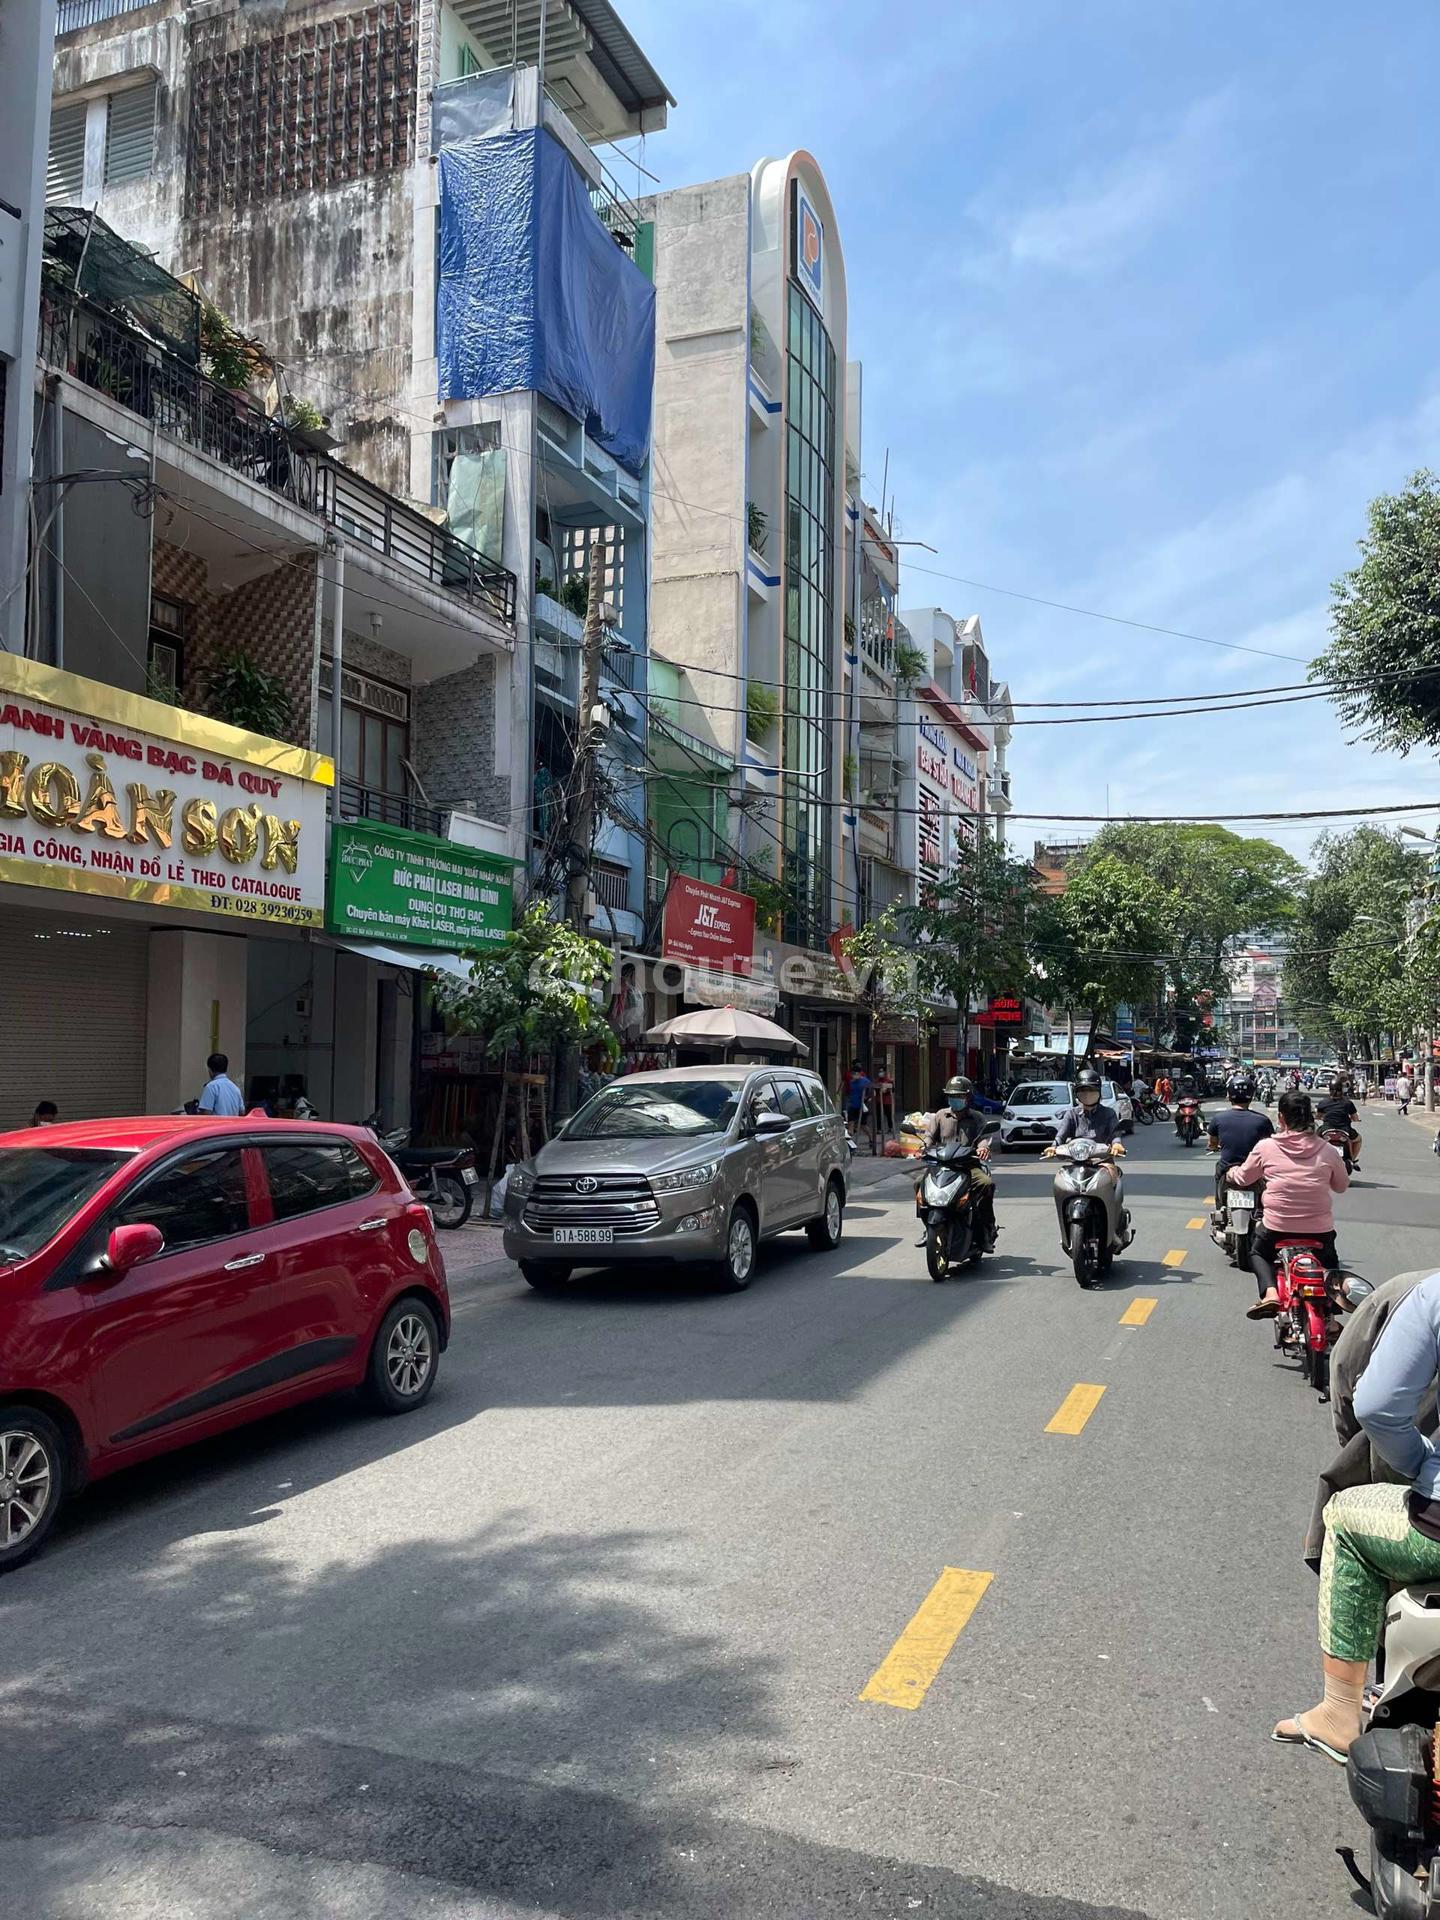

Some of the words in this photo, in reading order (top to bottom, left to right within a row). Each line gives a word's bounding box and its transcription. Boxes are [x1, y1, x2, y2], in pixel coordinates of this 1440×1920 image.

[70, 720, 143, 761] VÀNG
[147, 745, 197, 775] BẠC
[202, 761, 234, 786] ĐÁ
[238, 771, 283, 798] QUÝ
[181, 798, 301, 875] SƠN
[33, 837, 87, 868] CÔNG,
[90, 850, 134, 874] NHẬN
[140, 855, 161, 877] ĐỒ
[167, 859, 185, 882] LẺ
[191, 868, 226, 889] THEO
[231, 875, 302, 902] CATALOGUE
[374, 843, 395, 860] CÔNG
[396, 850, 405, 862] TY
[405, 853, 424, 866] TNHH
[392, 867, 413, 888] ĐỨC
[413, 872, 435, 893] PHÁT
[436, 878, 462, 898] LASER
[463, 882, 480, 902] HÒA
[211, 895, 233, 911] ĐT:
[235, 899, 257, 914] 028
[260, 902, 313, 921] 39230259
[346, 904, 378, 923] Chuyên
[378, 910, 394, 923] bán
[394, 913, 411, 929] máy
[485, 927, 506, 941] LASER
[408, 898, 433, 915] DỤNG
[434, 903, 447, 919] CỤ
[449, 906, 466, 923] THỢ
[467, 909, 485, 925] BẠC
[693, 903, 720, 928] J&T
[713, 920, 731, 932] EXPRESS
[554, 1229, 612, 1242] 61A-588.99
